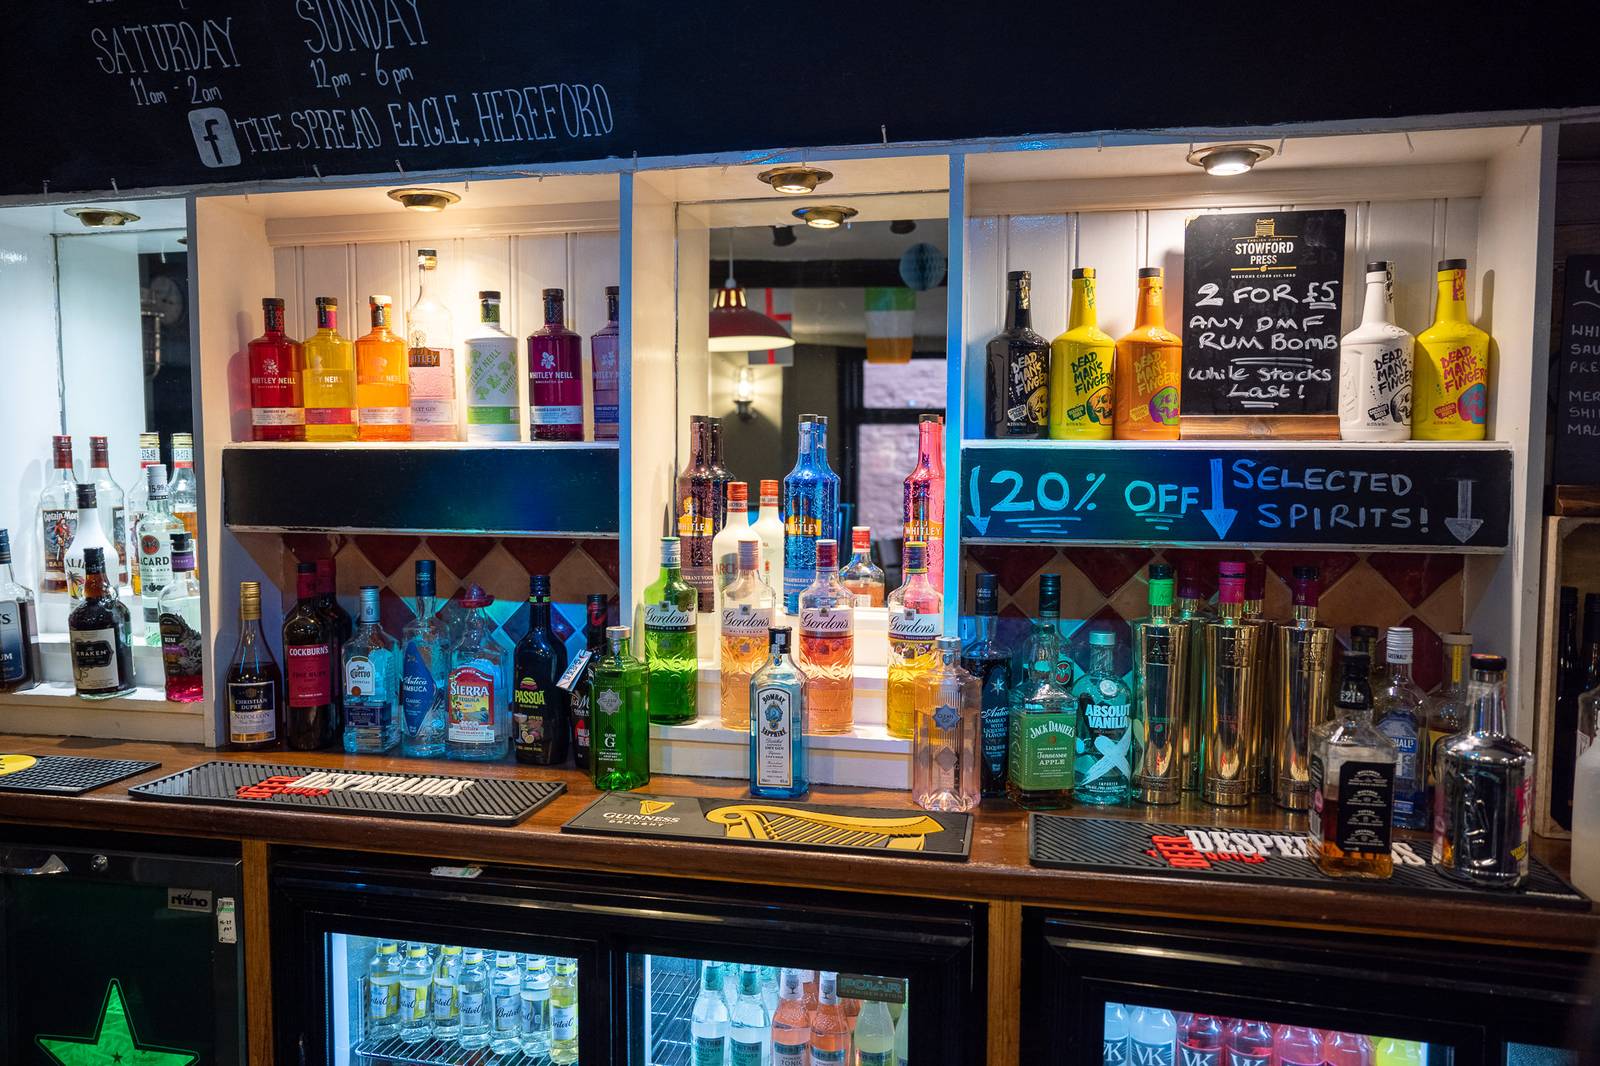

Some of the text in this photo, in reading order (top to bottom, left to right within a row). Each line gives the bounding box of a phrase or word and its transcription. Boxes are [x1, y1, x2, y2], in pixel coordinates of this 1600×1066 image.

[296, 0, 429, 53] SUNDAY
[91, 17, 241, 74] SATURDAY
[310, 58, 351, 98] 12pm
[130, 77, 167, 106] 11am
[234, 113, 291, 152] THE
[290, 106, 382, 150] SPREAD
[472, 83, 613, 143] HEREFORD
[1235, 242, 1294, 255] STOWFORD
[1250, 255, 1278, 265] PRESS
[1195, 281, 1339, 307] 2 FOR £5
[1189, 315, 1243, 331] ANY
[1571, 324, 1600, 337] WHI
[1199, 332, 1265, 350] RUM
[1440, 345, 1472, 369] DEAD
[1570, 344, 1600, 356] SAU
[1011, 352, 1038, 373] DEAD
[1070, 351, 1098, 372] DEAD
[1133, 351, 1162, 372] DEAD
[1373, 348, 1403, 370] DEAD
[1569, 361, 1600, 373] PRE
[530, 371, 573, 379] WHITLEY NEILL
[1014, 363, 1042, 384] MAN'S
[1073, 361, 1104, 384] MAN'S
[1136, 362, 1168, 384] MAN'S
[1376, 358, 1408, 382] MAN'S
[1443, 356, 1478, 382] MAN'S
[251, 377, 296, 385] WHITLEY NEILL
[1568, 391, 1600, 402] MER
[1568, 408, 1600, 418] SHI
[1567, 424, 1600, 436] MAL
[1232, 459, 1413, 496] SELECTED
[990, 470, 1200, 514] 20% OFF
[66, 511, 80, 520] Mor
[785, 523, 818, 533] WHITLEY
[905, 526, 941, 536] WHITLEY
[645, 607, 690, 625] Gordon's
[722, 609, 770, 628] Gordon's
[802, 611, 849, 630] Gordon's
[889, 615, 936, 634] Gordon's
[75, 649, 107, 657] KRAKEN
[289, 645, 329, 656] COCKBURN'S
[349, 669, 371, 679] Cuervo
[450, 681, 490, 697] SIERRA
[762, 693, 787, 705] BOMBAY
[1085, 704, 1131, 717] ABSOLUT
[761, 726, 788, 738] SAPPHIRE
[1030, 723, 1049, 739] JACK
[1037, 752, 1068, 760] Tennessee
[603, 812, 681, 823] GUINNESS
[171, 891, 208, 907] rhino
[1135, 1043, 1167, 1066] VK
[1182, 1047, 1213, 1066] VK
